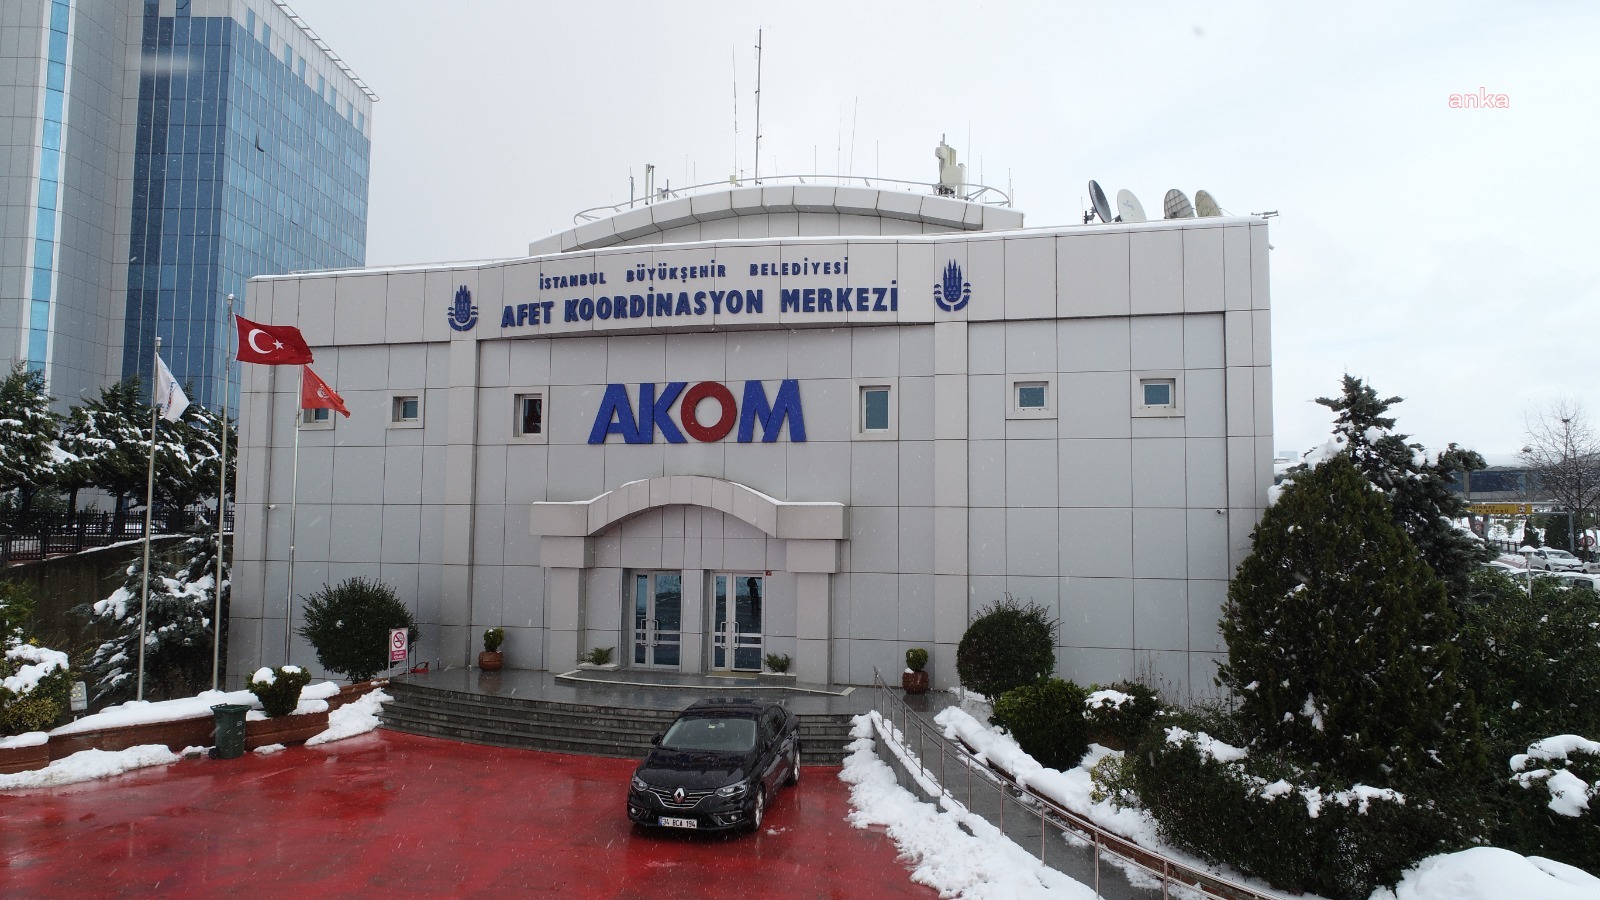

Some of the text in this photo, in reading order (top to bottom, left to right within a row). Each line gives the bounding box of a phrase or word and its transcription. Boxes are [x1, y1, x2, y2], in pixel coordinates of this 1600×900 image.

[540, 257, 849, 290] İSTANBUL BÜYÜKŞEHİR BELEDİYESİ
[501, 280, 898, 327] AFET KOORDİNASYON MERKEZİ
[587, 379, 806, 444] AKOM
[686, 820, 696, 828] 194
